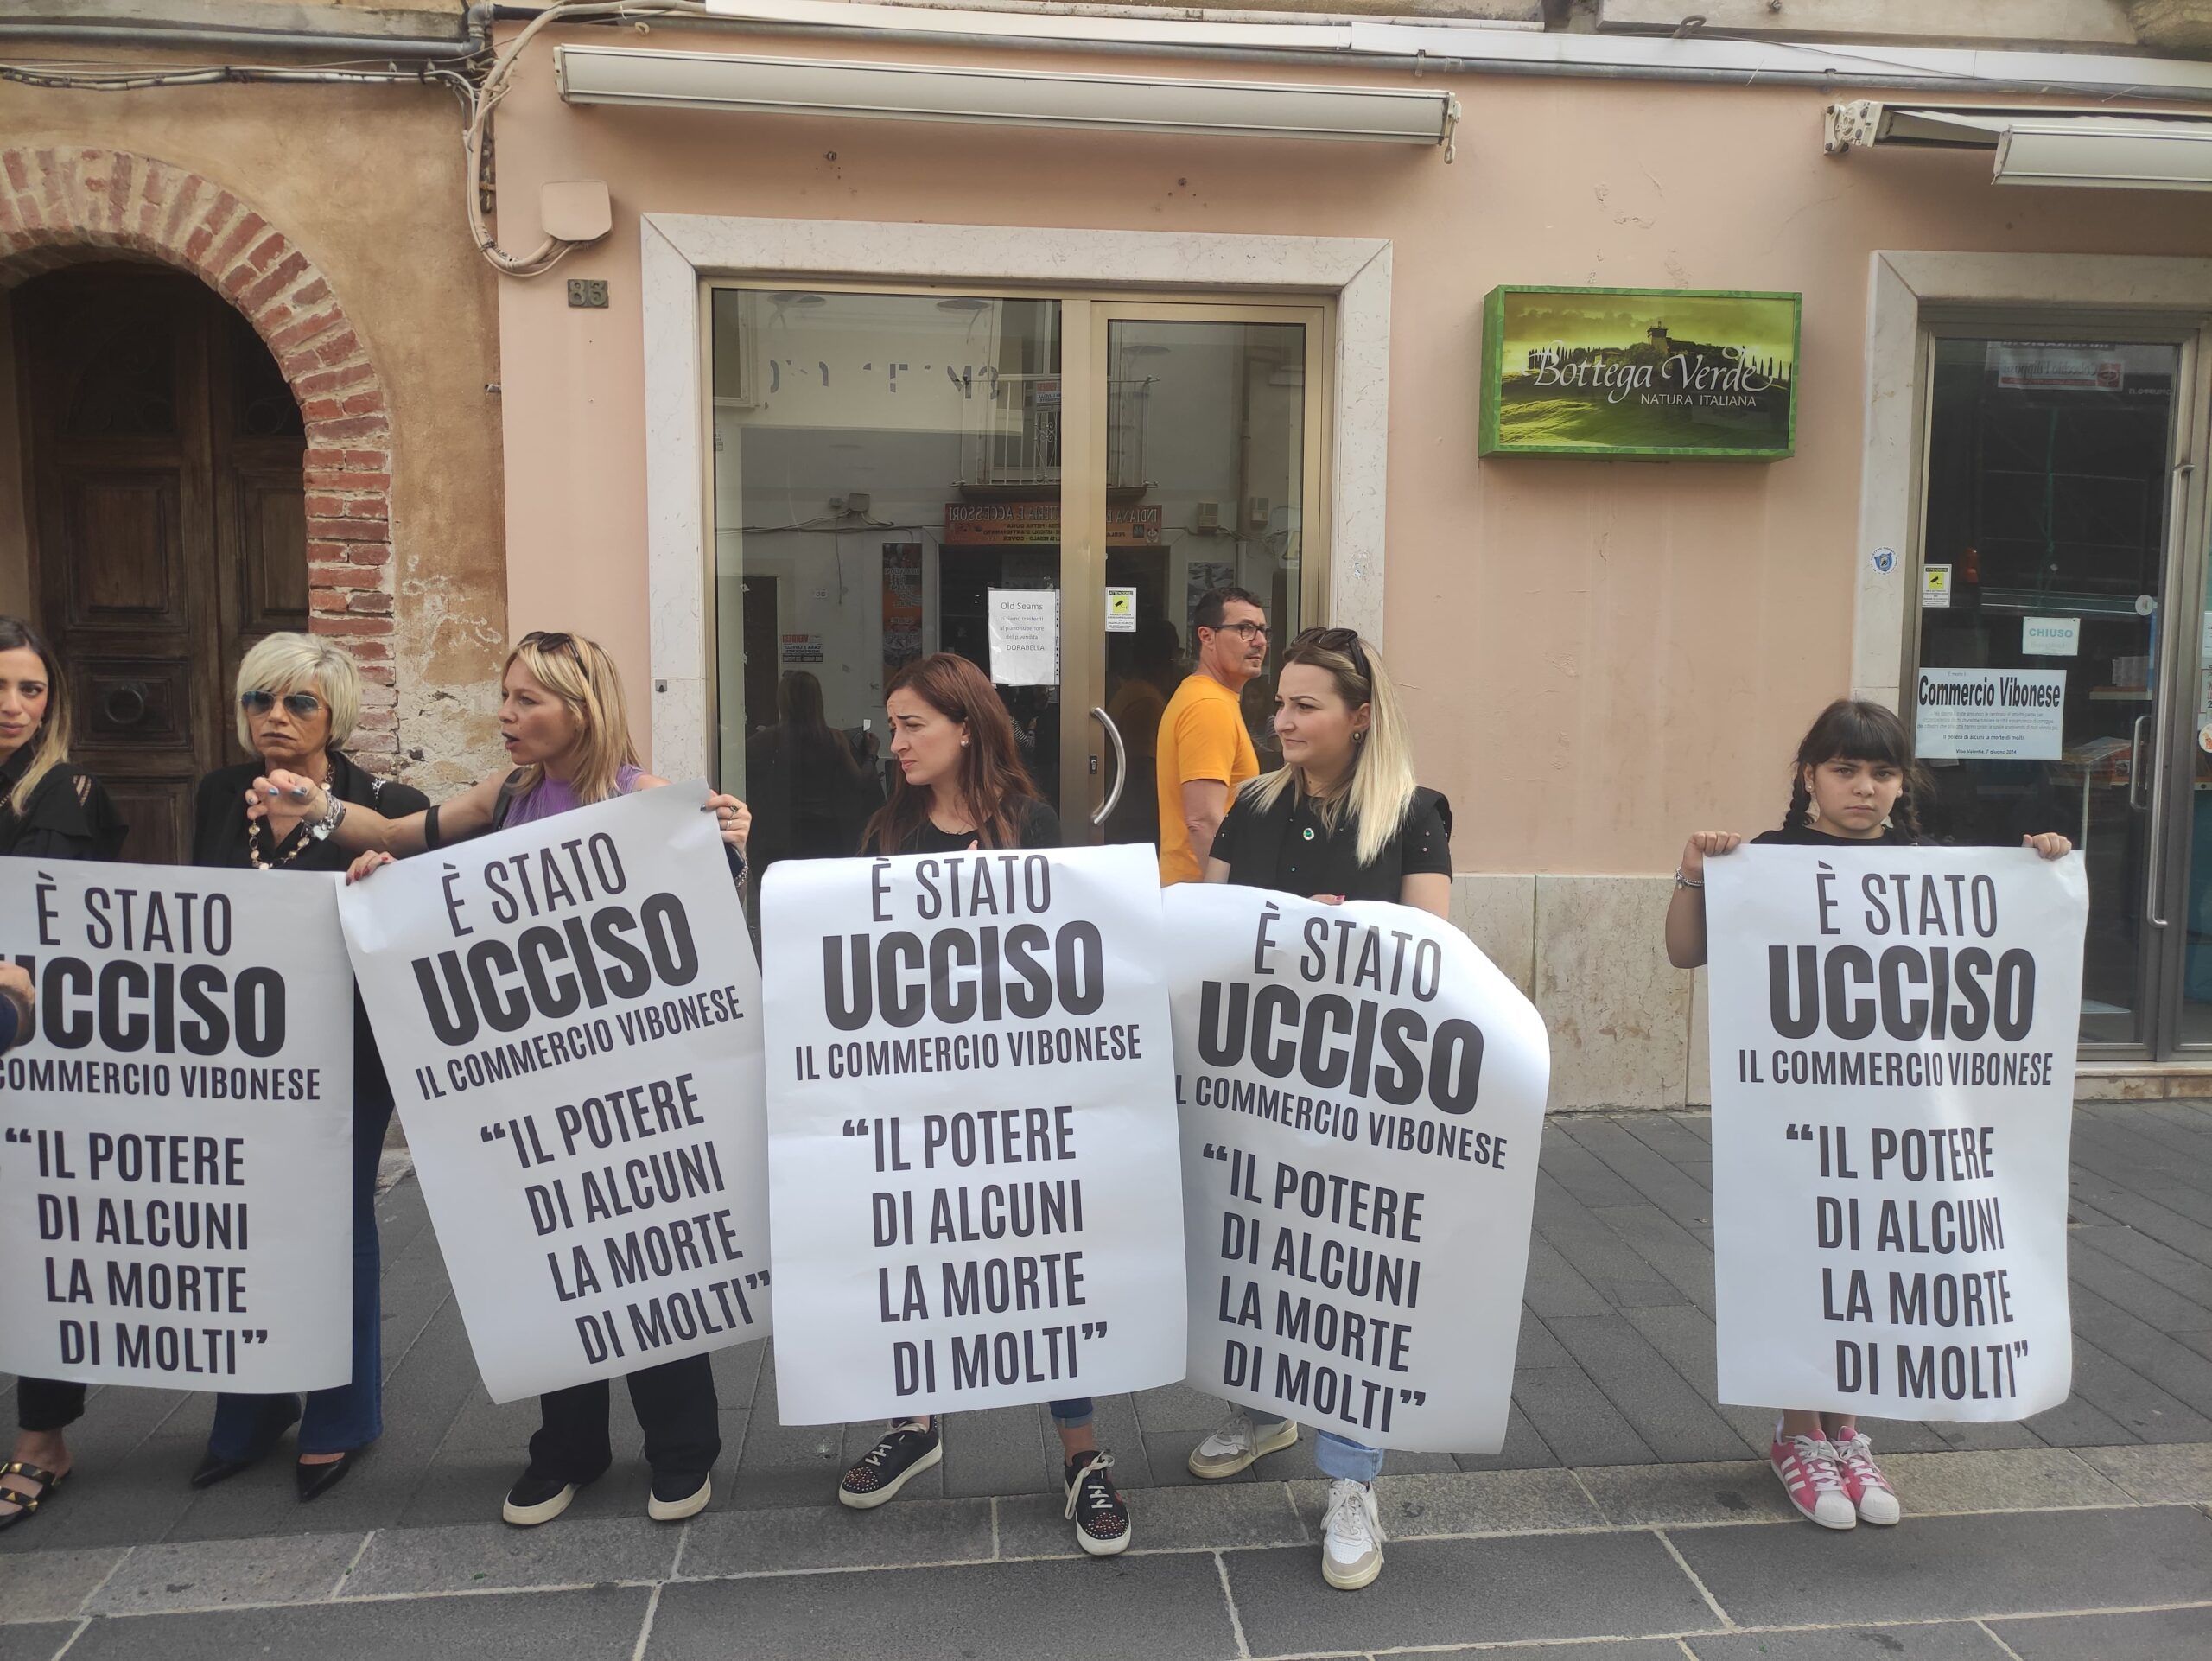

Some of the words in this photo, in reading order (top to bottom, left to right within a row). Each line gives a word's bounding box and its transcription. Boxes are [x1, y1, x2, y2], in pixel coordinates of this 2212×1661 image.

[1522, 340, 1652, 404] Bottega
[1662, 346, 1773, 392] Verde
[1641, 393, 1693, 405] NATURA
[1700, 395, 1757, 407] ITALIANA
[2029, 628, 2073, 638] CHIUSO
[1918, 675, 1995, 707] Commercio
[1999, 677, 2060, 708] Vibonese
[36, 871, 60, 945] È
[85, 888, 231, 956] STATO
[442, 863, 474, 937] È
[484, 832, 626, 924] STATO
[872, 859, 893, 922] È
[916, 855, 1050, 920] STATO
[1816, 861, 1840, 934] È
[1862, 874, 1997, 938] STATO
[411, 893, 700, 1047] UCCISO
[823, 920, 1104, 1031] UCCISO
[1255, 901, 1280, 974] È
[1300, 917, 1441, 1002] STATO
[1769, 945, 2035, 1041] UCCISO
[416, 1066, 447, 1100] IL
[447, 1019, 614, 1091] COMMERCIO
[616, 985, 744, 1046] VIBONESE
[796, 1046, 820, 1080] IL
[829, 1034, 998, 1079] COMMERCIO
[1007, 1024, 1141, 1066] VIBONESE
[1198, 981, 1484, 1115] UCCISO
[1739, 1050, 1764, 1083] IL
[1772, 1050, 1942, 1087] COMMERCIO
[1948, 1053, 2053, 1085] VIBONESE
[180, 1066, 320, 1100] VIBONESE
[555, 1073, 704, 1156] POTERE
[924, 1106, 1076, 1168] POTERE
[1196, 1076, 1358, 1141] COMMERCIO
[1370, 1112, 1507, 1170] VIBONESE
[1872, 1127, 1993, 1181] POTERE
[89, 1132, 244, 1185] POTERE
[525, 1179, 574, 1236] DI
[582, 1141, 725, 1223] ALCUNI
[38, 1194, 79, 1241] DI
[96, 1198, 247, 1250] ALCUNI
[873, 1191, 913, 1247] DI
[930, 1180, 1083, 1244] ALCUNI
[1274, 1162, 1424, 1243] POTERE
[1817, 1196, 1859, 1250] DI
[1878, 1197, 2004, 1254] ALCUNI
[46, 1257, 93, 1304] LA
[107, 1261, 246, 1313] MORTE
[547, 1245, 601, 1301] LA
[604, 1209, 743, 1288] MORTE
[879, 1265, 929, 1322] LA
[942, 1251, 1085, 1317] MORTE
[1221, 1212, 1260, 1265] DI
[1272, 1227, 1420, 1308] ALCUNI
[1219, 1276, 1262, 1330] LA
[1276, 1290, 1412, 1372] MORTE
[1822, 1268, 1873, 1322] LA
[1890, 1270, 2013, 1327] MORTE
[60, 1320, 100, 1365] DI
[575, 1310, 625, 1364] DI
[893, 1340, 935, 1396] DI
[1224, 1340, 1262, 1392] DI
[1836, 1340, 1878, 1395] DI
